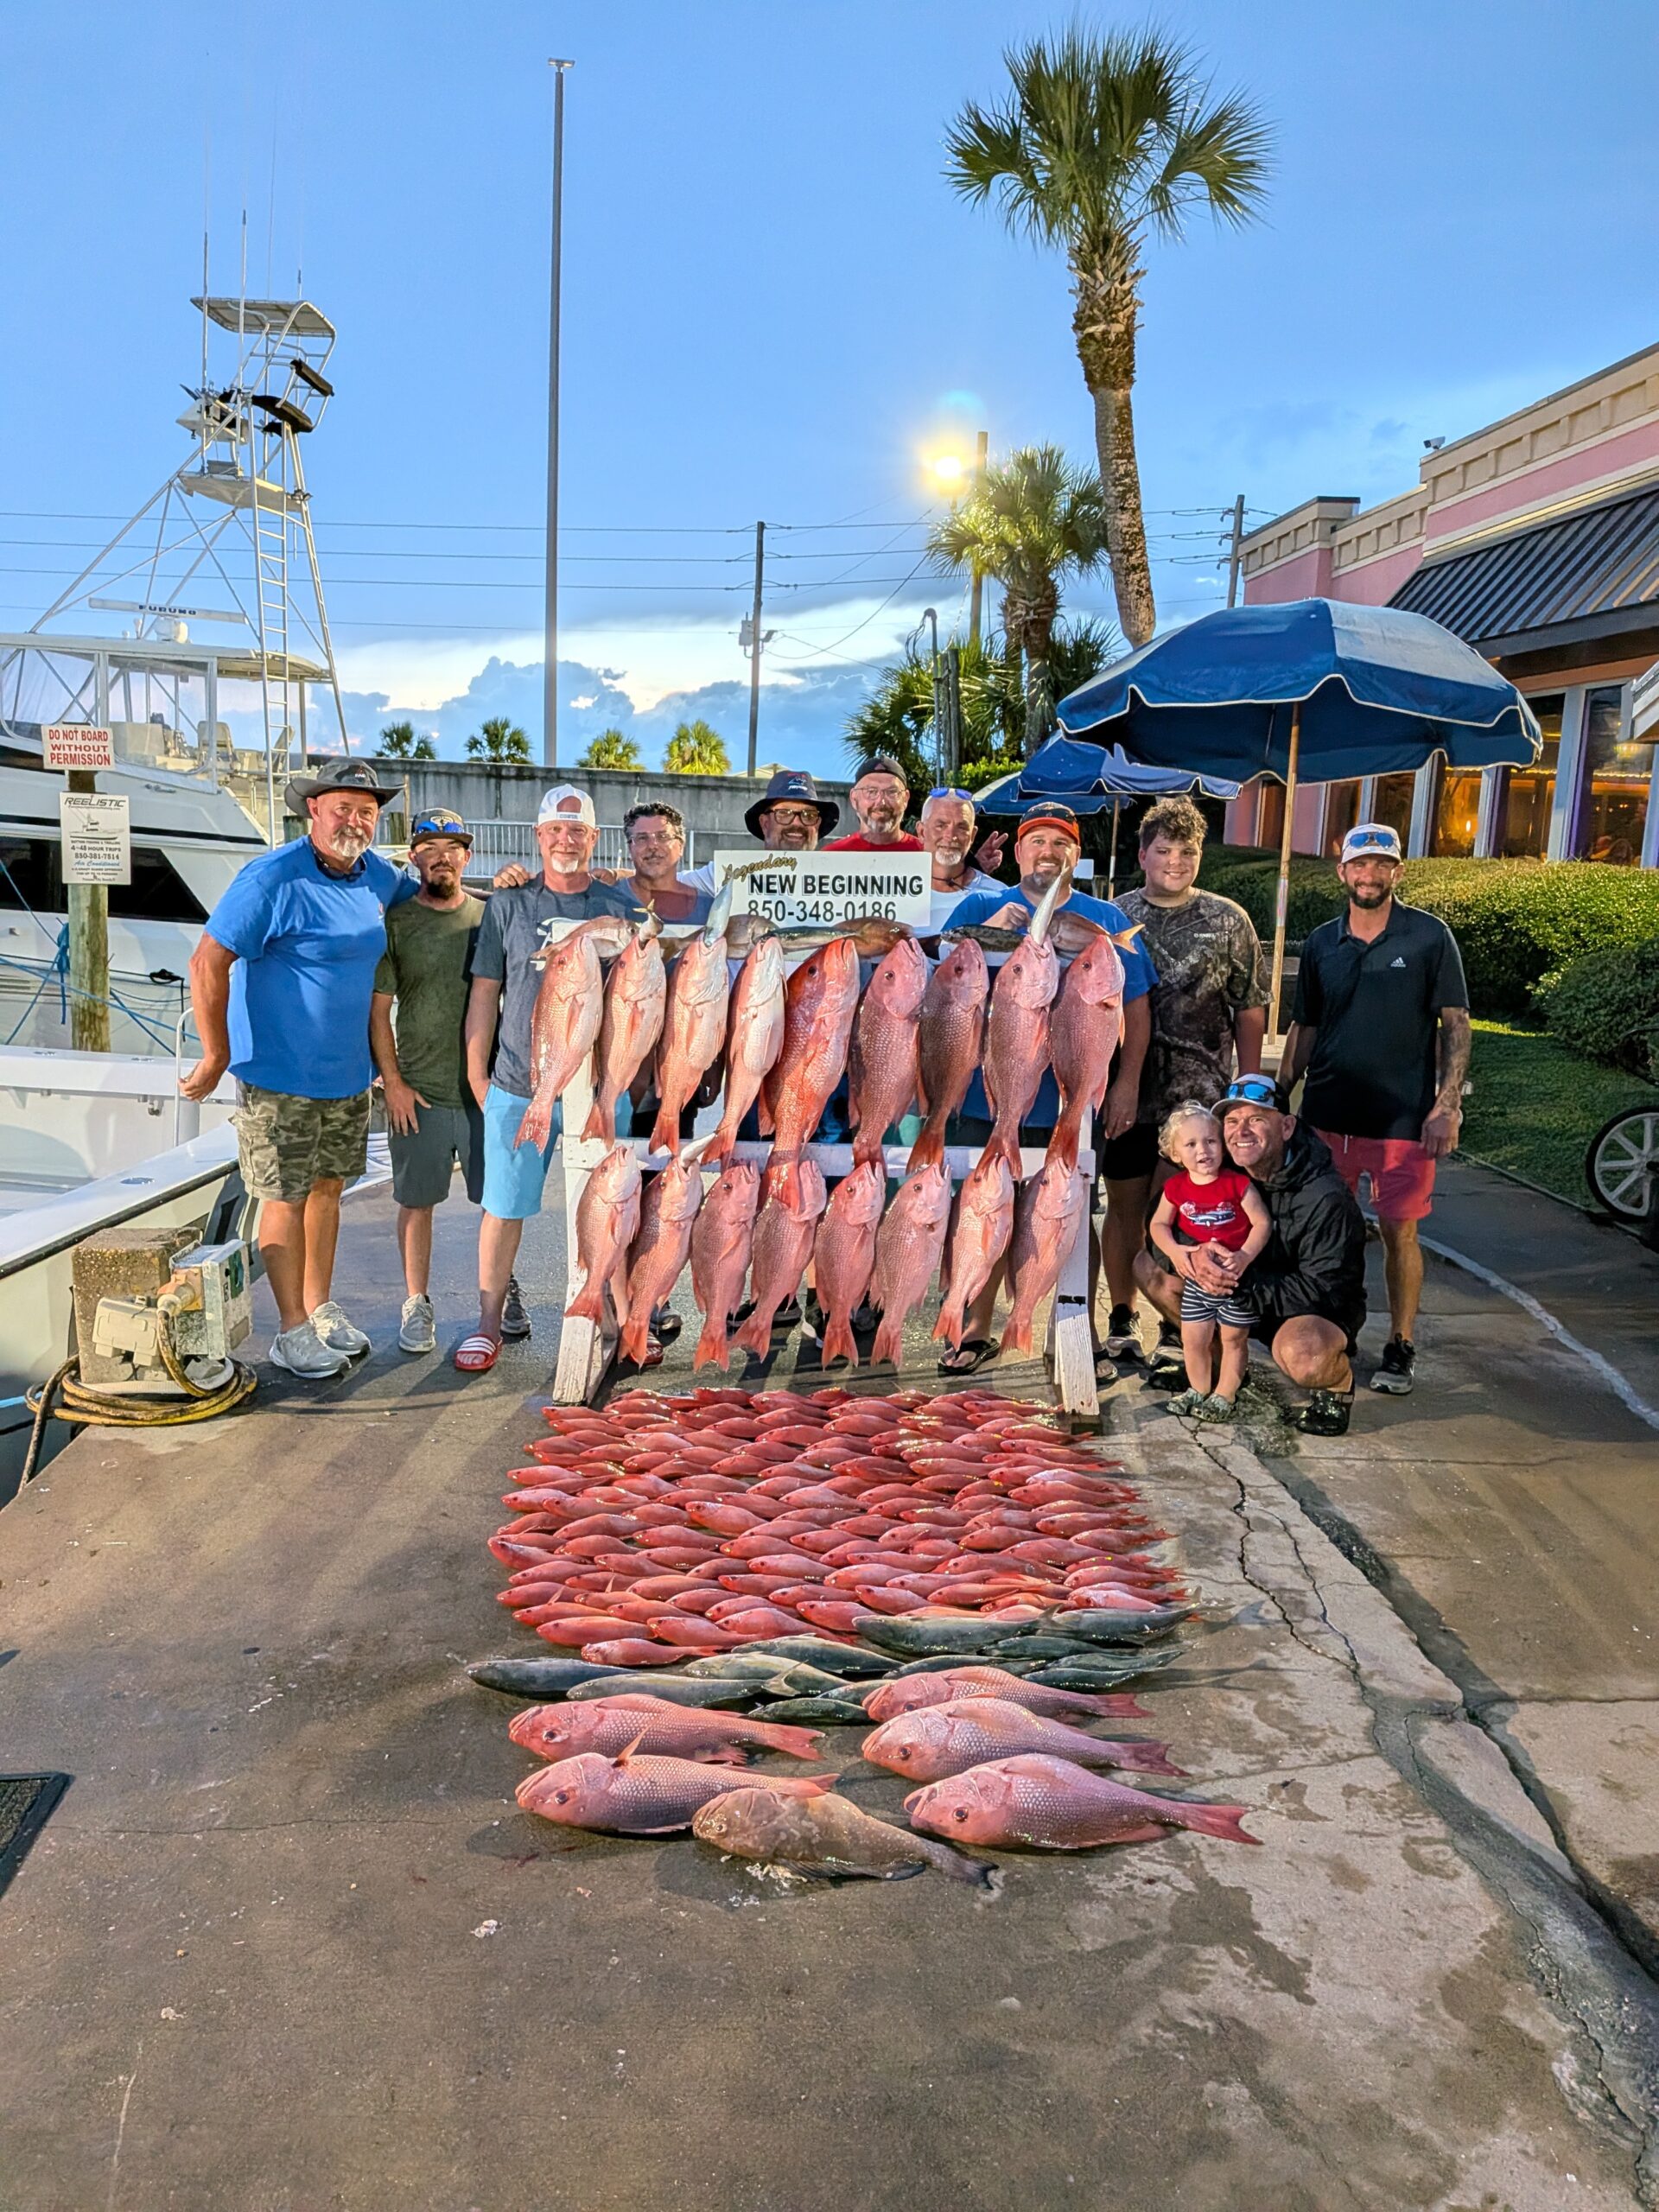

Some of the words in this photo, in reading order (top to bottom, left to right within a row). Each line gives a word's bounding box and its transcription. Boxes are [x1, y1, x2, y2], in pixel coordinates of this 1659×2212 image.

[48, 729, 60, 741] DO
[62, 729, 79, 741] NOT
[81, 730, 109, 742] BOARD
[51, 743, 109, 753] WITHOUT
[50, 753, 111, 766] PERMISSION
[64, 797, 127, 808] REELISTIC
[74, 852, 120, 861] 850-381-7514
[748, 874, 797, 896] NEW
[802, 874, 923, 898] BEGINNING
[748, 899, 896, 922] 850-348-0186
